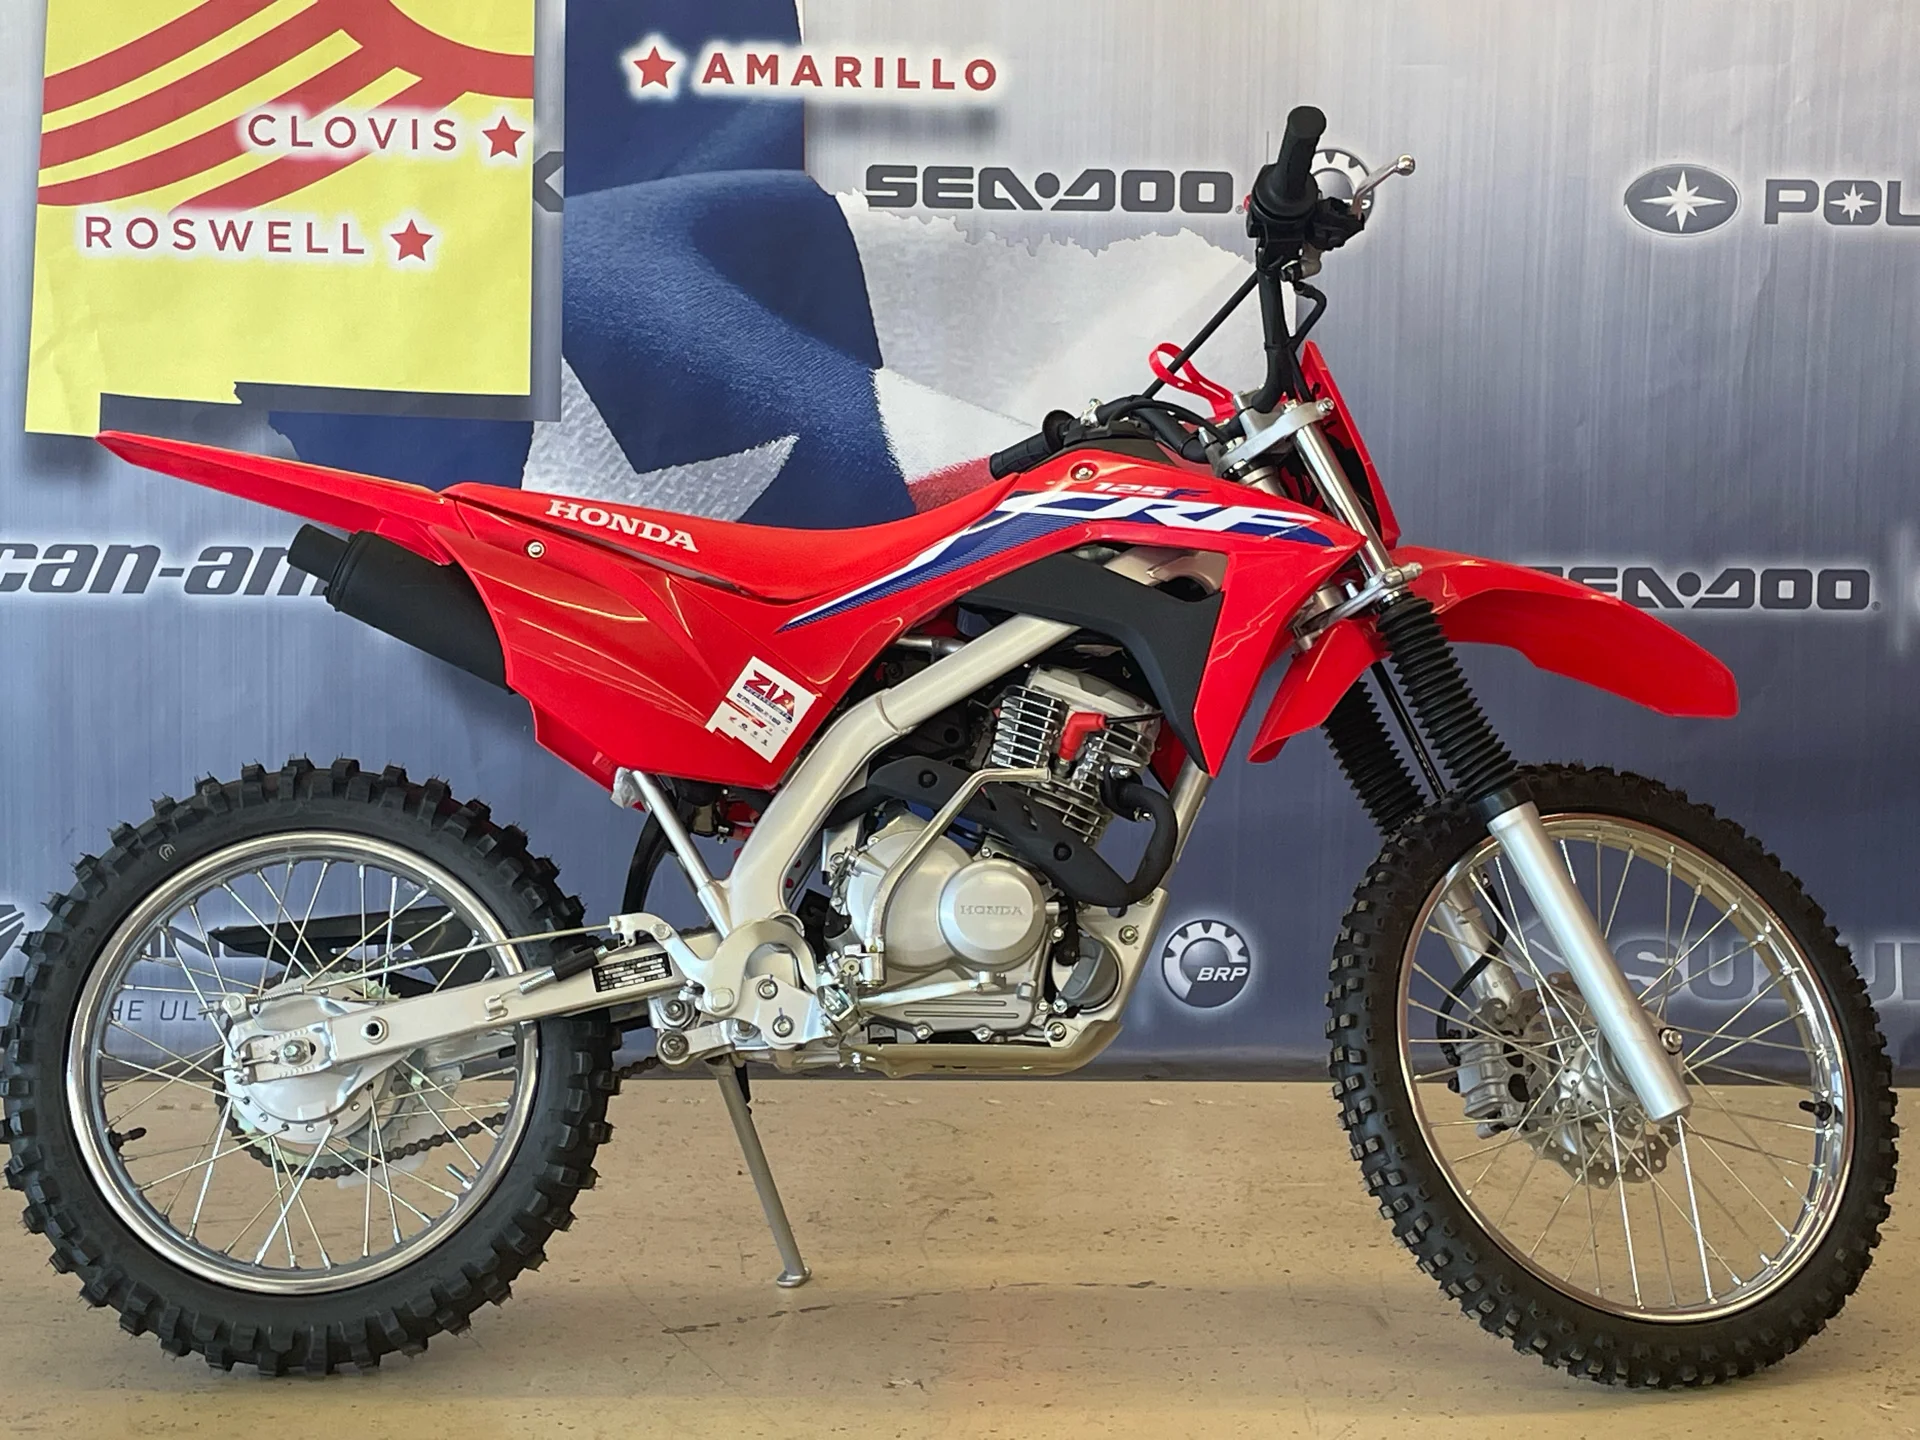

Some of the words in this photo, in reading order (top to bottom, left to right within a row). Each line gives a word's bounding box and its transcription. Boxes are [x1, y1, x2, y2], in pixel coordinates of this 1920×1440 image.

[702, 52, 997, 92] AMARILLO
[248, 113, 458, 151] CLOVIS
[84, 216, 365, 255] ROSWELL
[545, 499, 699, 553] HONDA
[996, 491, 1321, 531] CRF
[744, 669, 795, 718] ZIA
[960, 904, 1025, 916] HONDA
[1196, 966, 1248, 982] BRP
